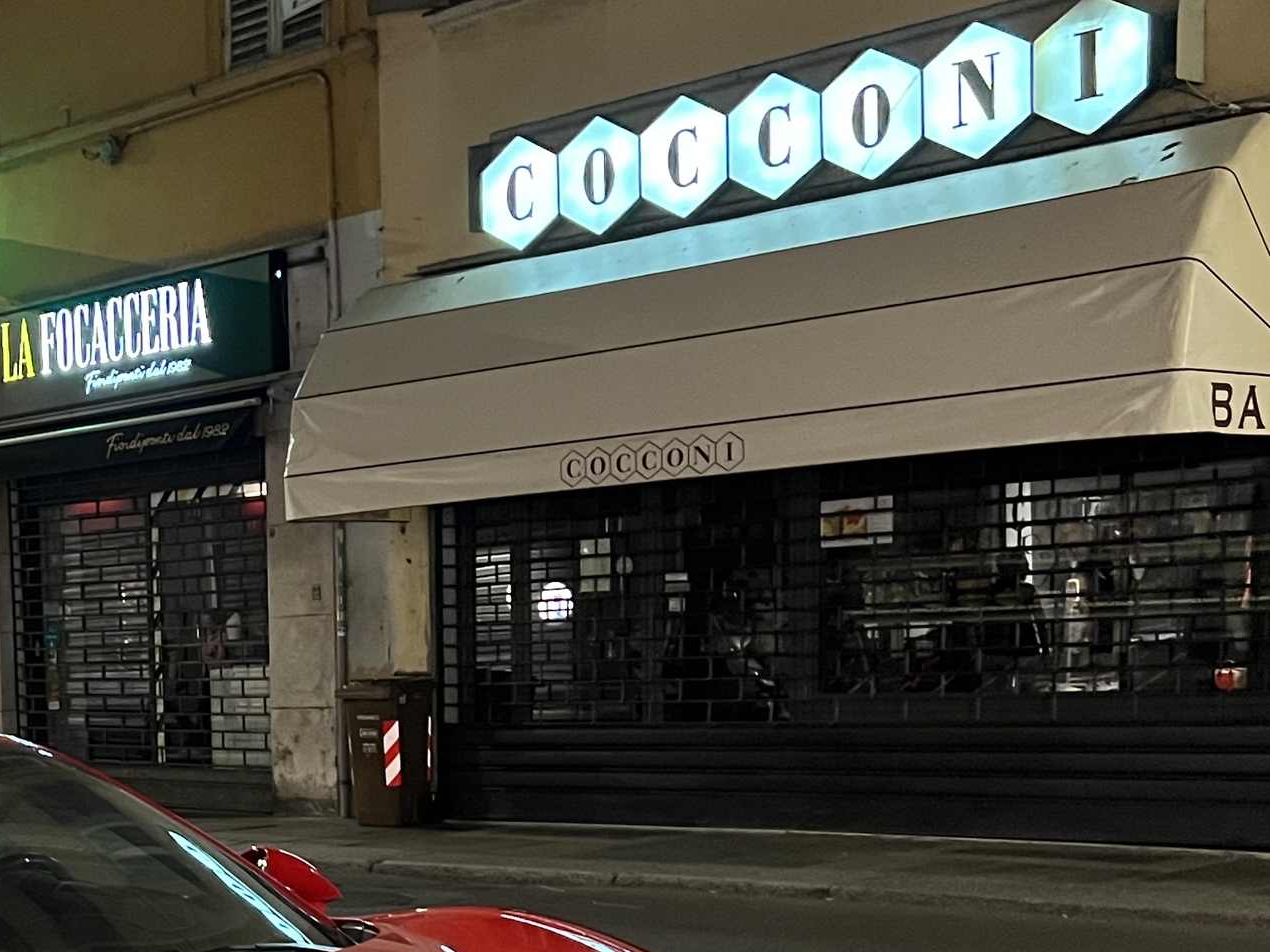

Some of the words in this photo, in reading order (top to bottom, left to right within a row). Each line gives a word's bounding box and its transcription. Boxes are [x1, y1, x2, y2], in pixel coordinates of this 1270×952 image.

[506, 27, 1104, 221] COCCONI
[0, 317, 36, 383] LA
[39, 278, 213, 375] FOCACCERIA
[1211, 382, 1266, 430] BA
[176, 422, 201, 442] dal
[567, 442, 734, 477] COCCONI
